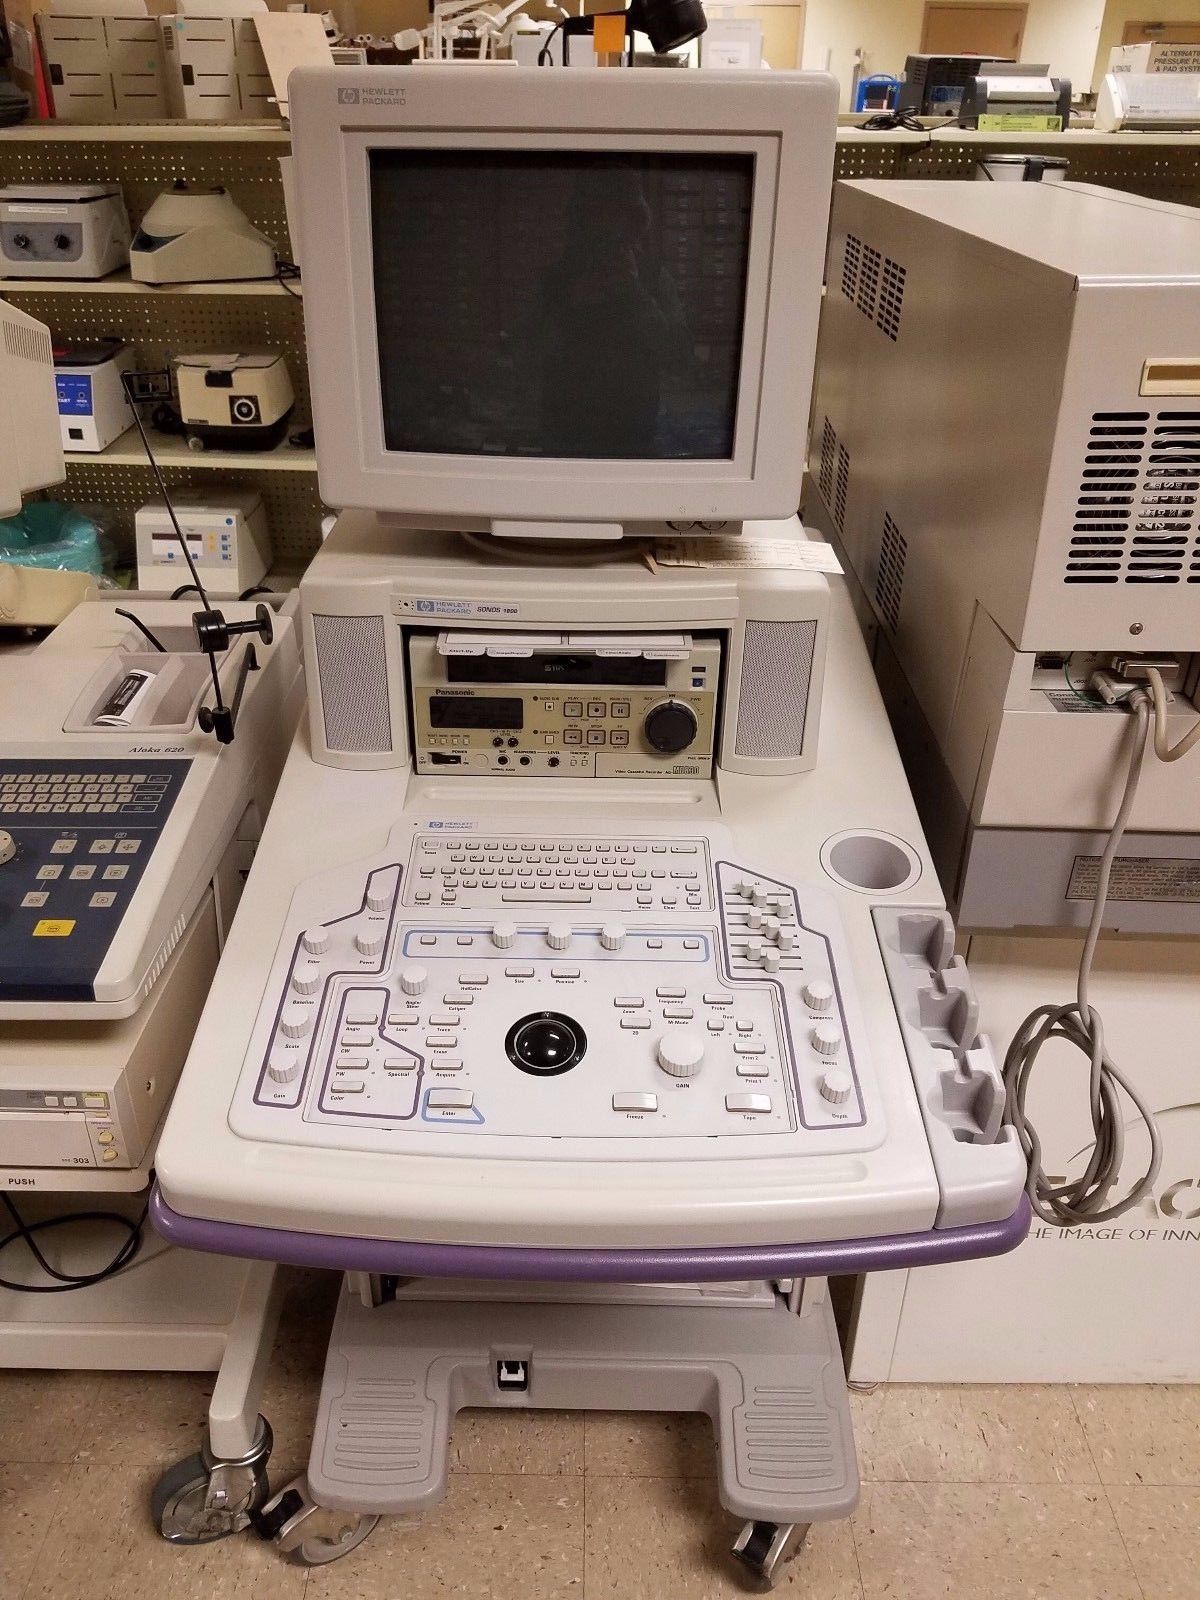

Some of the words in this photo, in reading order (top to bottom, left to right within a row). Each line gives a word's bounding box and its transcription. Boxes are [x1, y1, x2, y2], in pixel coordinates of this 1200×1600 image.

[362, 88, 406, 96] HEWLETT
[362, 97, 406, 106] PACKARD
[8, 1177, 36, 1186] PUSH
[1027, 1227, 1054, 1239] HE
[1058, 1227, 1123, 1240] IMAGE
[1128, 1229, 1159, 1241] OF
[1162, 1230, 1200, 1241] INN
